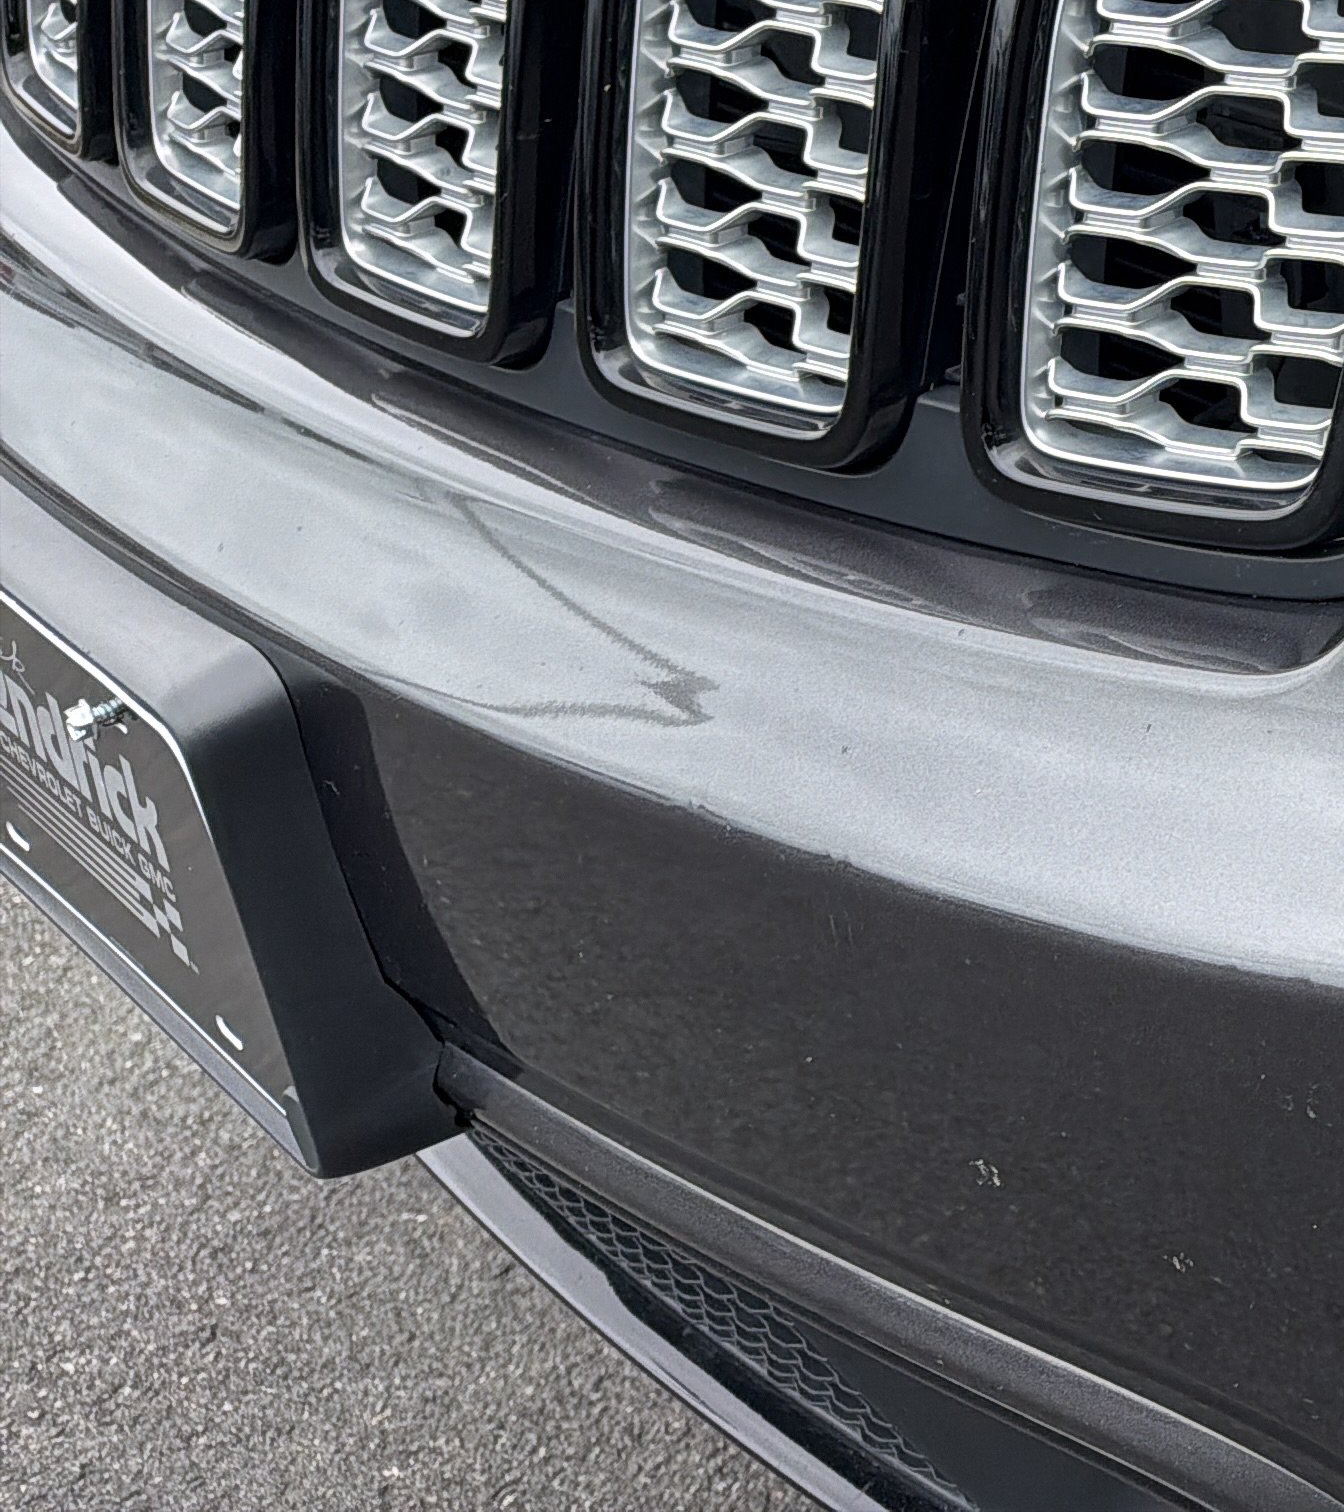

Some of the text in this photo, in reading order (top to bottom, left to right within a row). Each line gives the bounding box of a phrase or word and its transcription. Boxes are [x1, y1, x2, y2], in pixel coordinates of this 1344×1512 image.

[0, 730, 177, 903] CHEVROLET BUICK GMC
